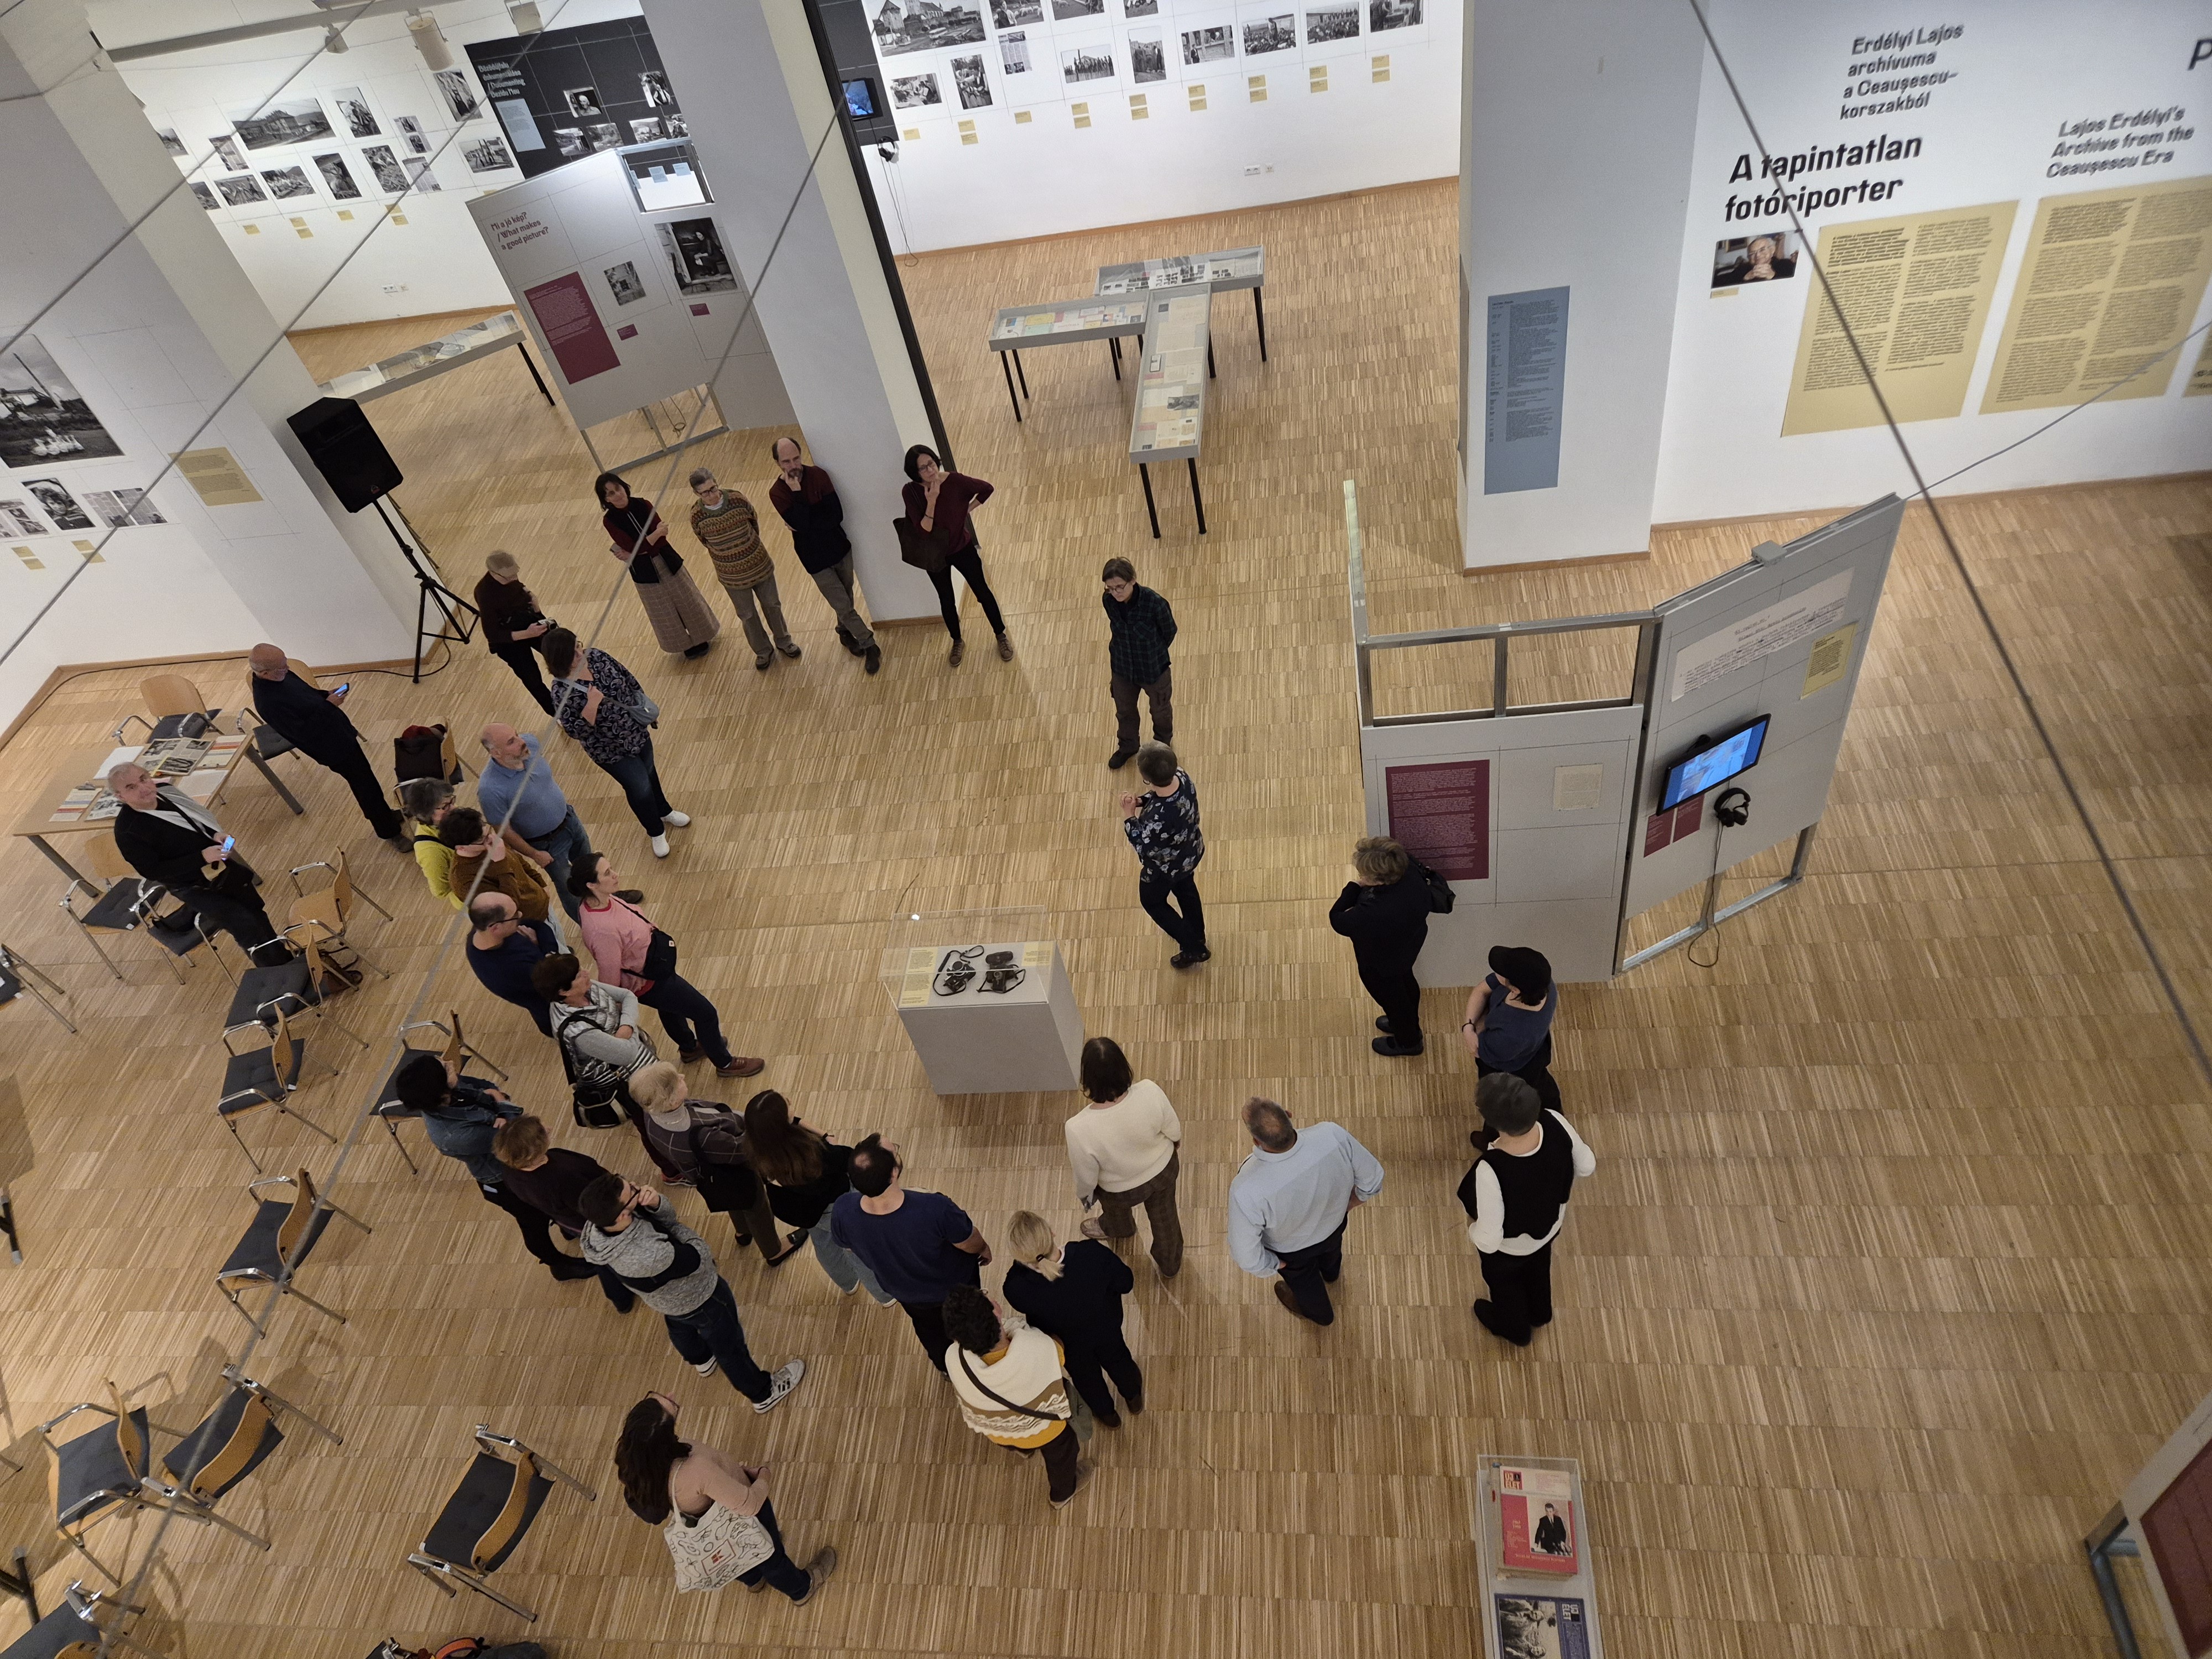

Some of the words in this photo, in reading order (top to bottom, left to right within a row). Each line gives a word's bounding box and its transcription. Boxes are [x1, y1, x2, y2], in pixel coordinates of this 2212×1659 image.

[1851, 29, 1914, 55] Erdélyi
[1916, 23, 1965, 46] Lajos
[1848, 51, 1937, 77] archívuma
[1843, 86, 1853, 98] a
[1840, 91, 1931, 120] korszakból
[2058, 118, 2107, 138] Lajos
[2051, 138, 2120, 158] Archive
[2122, 132, 2164, 149] from
[2166, 125, 2195, 143] the
[1729, 154, 1752, 184] A
[1761, 134, 1923, 182] tapintatlan
[2141, 149, 2174, 166] Era
[1725, 179, 1904, 222] fotóriporter
[491, 222, 500, 231] Mi
[511, 212, 527, 223] kép?
[520, 220, 541, 232] makes
[507, 237, 523, 250] good
[523, 226, 549, 243] picture?
